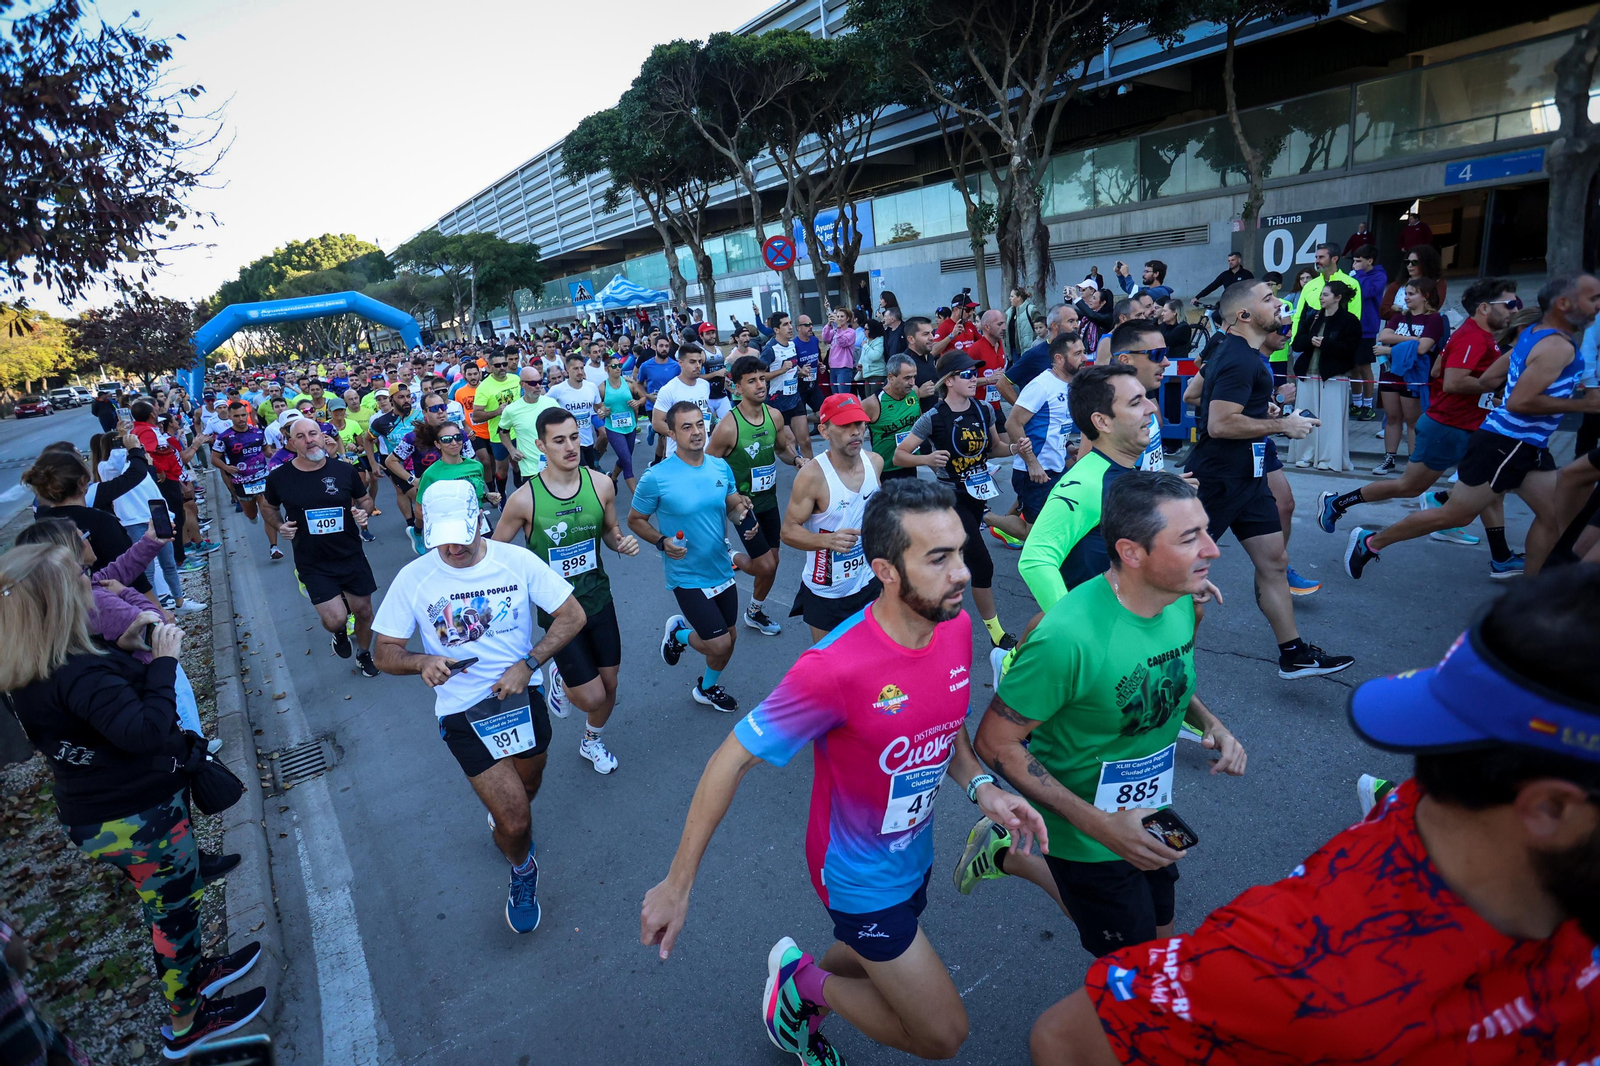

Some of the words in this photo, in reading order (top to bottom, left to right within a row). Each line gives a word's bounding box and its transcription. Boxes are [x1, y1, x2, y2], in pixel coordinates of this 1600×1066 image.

[1458, 164, 1473, 181] 4
[1267, 215, 1302, 226] Tribuna
[1263, 223, 1328, 275] 04
[261, 304, 315, 314] Ayuntamiento
[760, 474, 775, 486] 127
[974, 483, 990, 496] 762
[316, 518, 336, 529] 409
[562, 554, 587, 571] 898
[843, 555, 865, 573] 994
[450, 589, 486, 601] CARRERA
[486, 584, 519, 597] POPULAR
[1147, 647, 1181, 668] CARRERA
[1115, 662, 1147, 707] JEREZ
[489, 715, 506, 724] Carrera
[506, 709, 524, 719] Popular
[485, 723, 501, 731] Ciudad
[492, 728, 520, 748] 891
[1131, 759, 1152, 768] Carrera
[1153, 750, 1170, 762] Popular
[1151, 761, 1164, 770] Jerez
[905, 772, 920, 781] XLIII
[911, 777, 934, 788] Ciudad
[1116, 777, 1160, 804] 885
